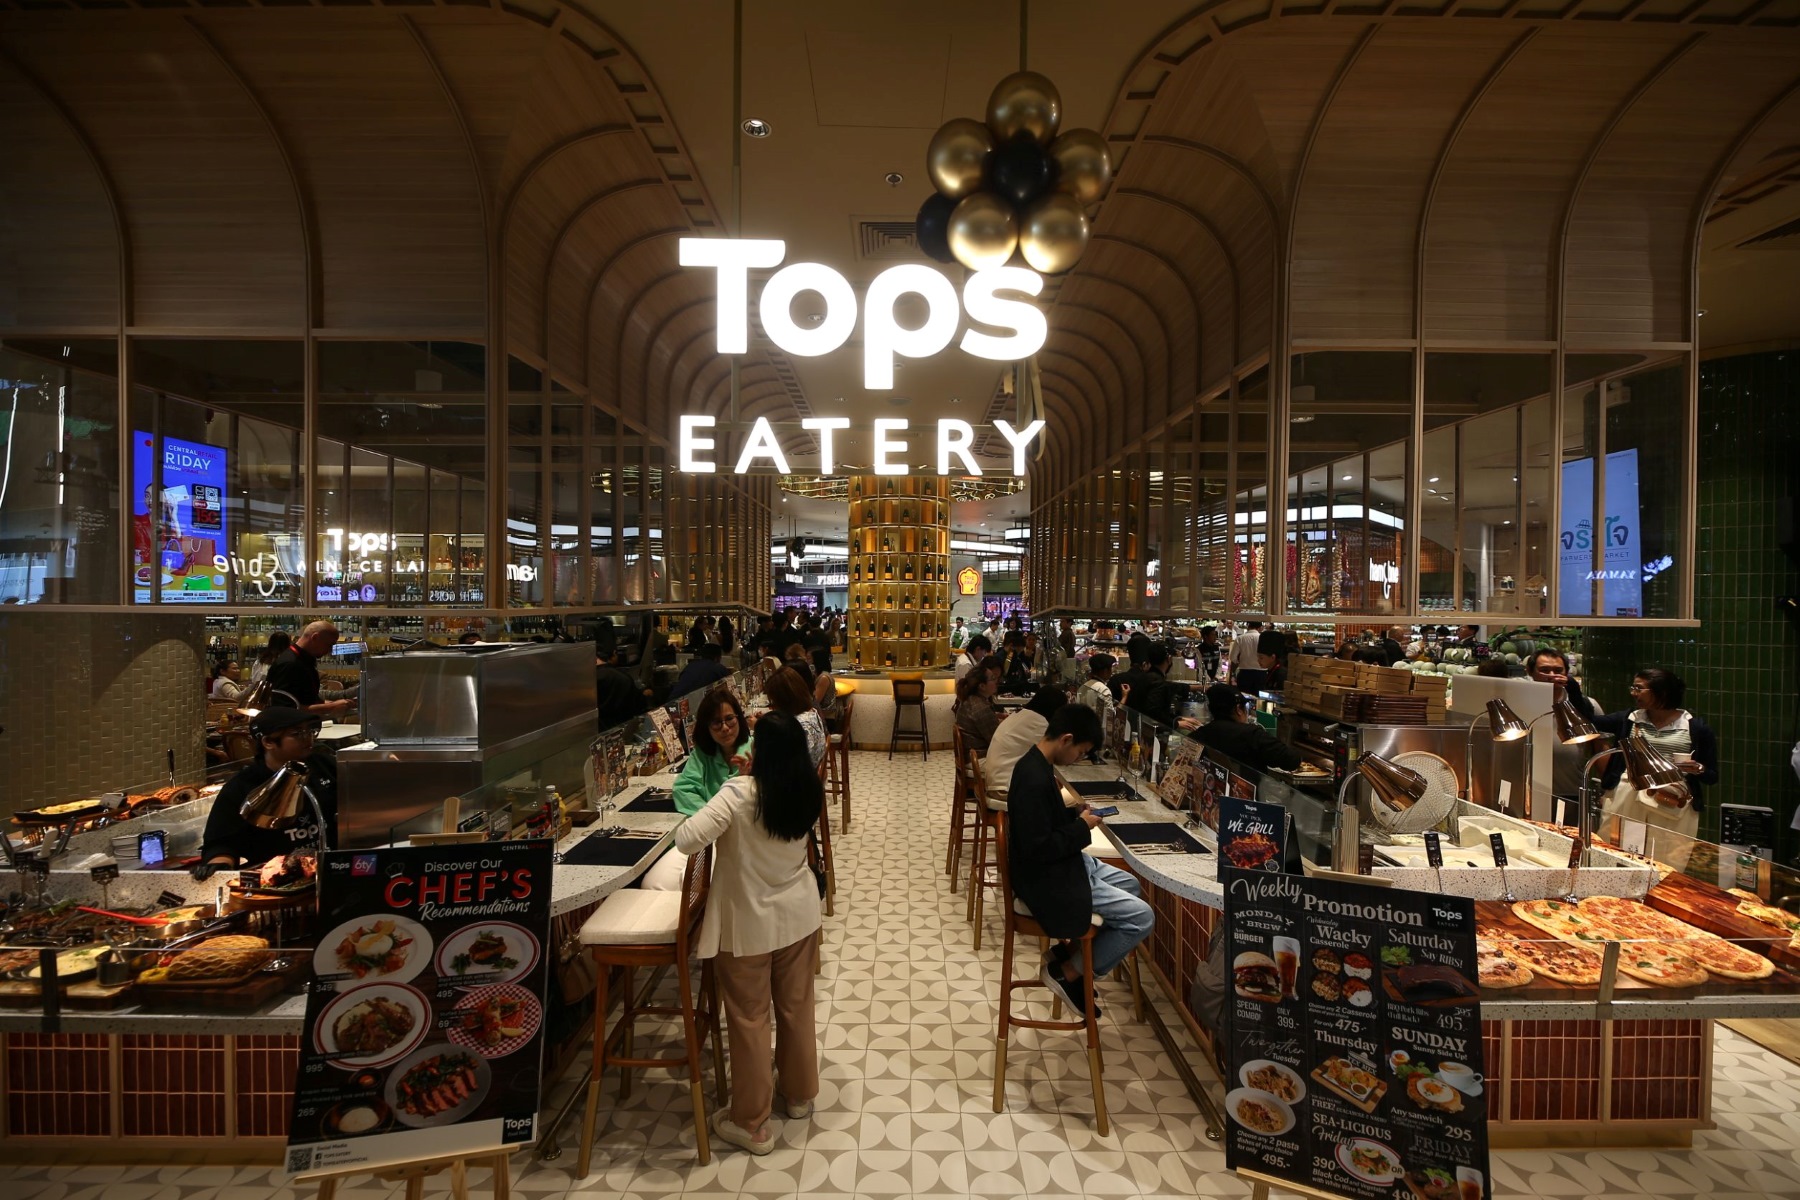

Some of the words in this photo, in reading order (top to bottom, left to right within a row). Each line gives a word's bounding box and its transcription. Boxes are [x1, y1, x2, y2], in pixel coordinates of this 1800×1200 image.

[679, 238, 1048, 390] Tops
[680, 415, 1046, 476] EATERY
[327, 528, 396, 557] Tops
[1604, 552, 1630, 564] ARKET
[1228, 818, 1244, 832] WE
[1245, 822, 1275, 835] GRILL
[330, 862, 350, 870] Tops
[425, 861, 477, 873] Discover
[479, 858, 503, 869] Our
[1230, 876, 1302, 904] Weekly
[418, 896, 532, 921] Recommendations
[1303, 893, 1423, 927] Promotion
[1432, 907, 1463, 921] Tops
[1234, 909, 1295, 926] MONDAY
[1233, 932, 1264, 943] BURGER
[1310, 936, 1350, 950] Casserole
[1316, 924, 1372, 949] Wacky
[1388, 928, 1457, 953] Saturday
[1420, 948, 1438, 961] Say
[1236, 1000, 1263, 1012] SPECIAL
[1341, 1007, 1377, 1020] Casserole
[1277, 1015, 1300, 1029] 399.-
[1314, 1029, 1378, 1055] Thursday
[1391, 1026, 1467, 1053] SUNDAY
[1272, 1053, 1301, 1066] Tuesday
[1412, 1044, 1436, 1055] Sunny
[1437, 1048, 1453, 1058] Side
[1311, 1099, 1336, 1111] FREE!
[1390, 1106, 1407, 1118] Any
[1407, 1110, 1443, 1125] sanwich
[504, 1118, 532, 1131] Tops
[1313, 1112, 1392, 1141] SEA-LICIOUS
[1236, 1130, 1257, 1141] Choose
[1257, 1136, 1268, 1144] any
[1269, 1136, 1276, 1145] 2
[1276, 1139, 1300, 1152] pasta
[1312, 1125, 1357, 1151] Friday
[1413, 1134, 1473, 1159] FRIDAY
[1236, 1137, 1254, 1147] dishes
[1261, 1144, 1274, 1152] your
[1274, 1147, 1294, 1157] choice
[1245, 1146, 1258, 1155] only
[1262, 1153, 1290, 1168] 495.-
[1312, 1168, 1332, 1180] Black
[1333, 1173, 1350, 1184] Cod
[1350, 1179, 1360, 1187] and
[1391, 1166, 1403, 1175] OR
[1311, 1176, 1325, 1184] with
[1325, 1179, 1341, 1190] White
[1342, 1182, 1358, 1192] Wine
